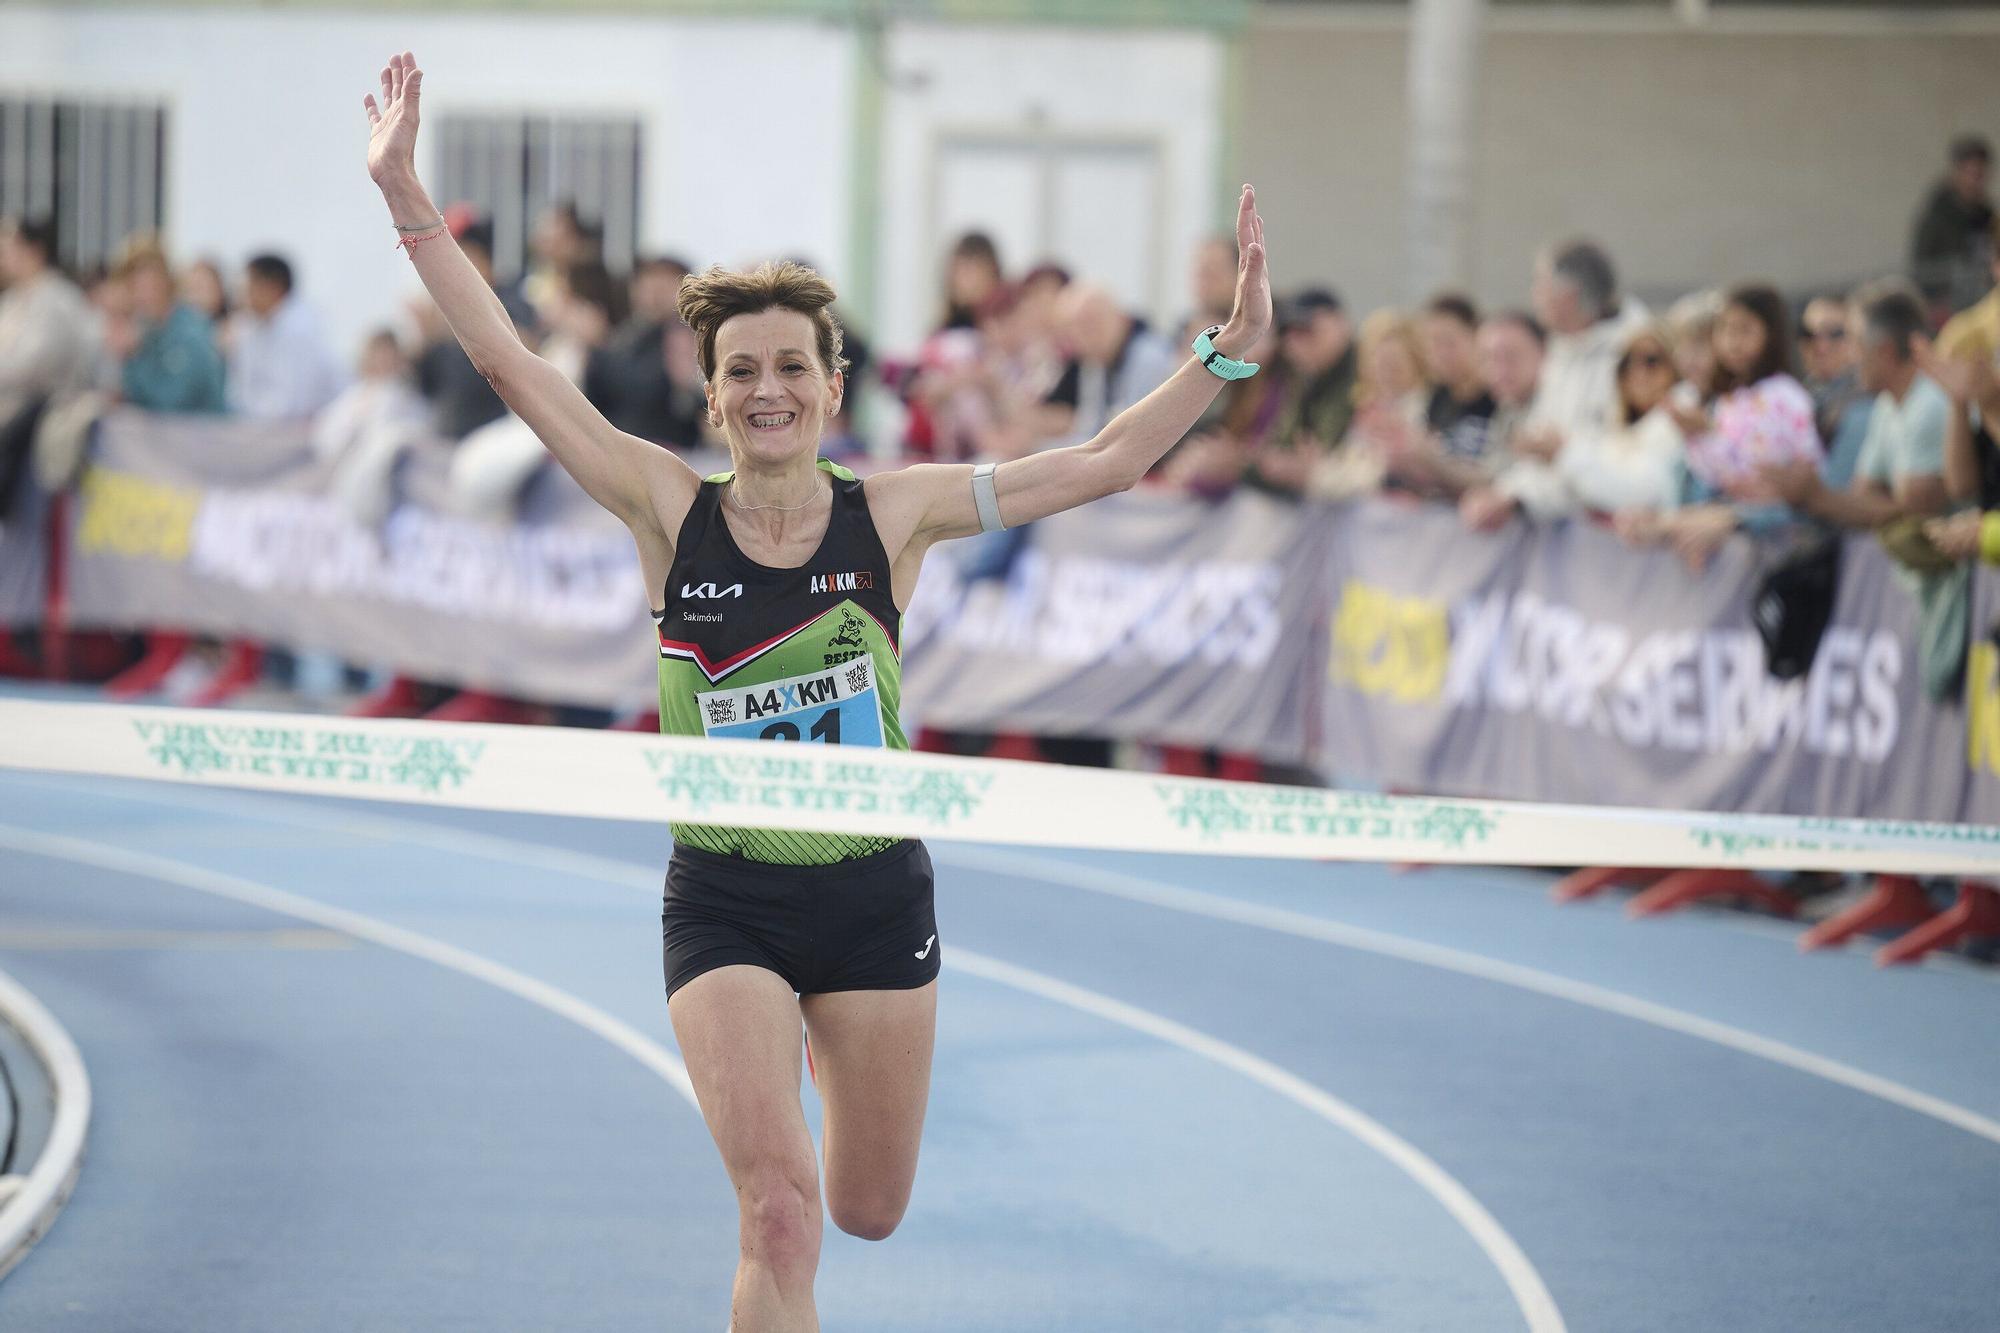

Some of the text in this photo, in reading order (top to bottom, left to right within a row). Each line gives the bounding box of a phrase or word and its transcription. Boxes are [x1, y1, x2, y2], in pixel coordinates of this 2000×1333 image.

[681, 582, 743, 599] KIA
[811, 572, 856, 594] A4XKM
[683, 611, 723, 622] Sakimóvil
[745, 675, 838, 720] A4XKM
